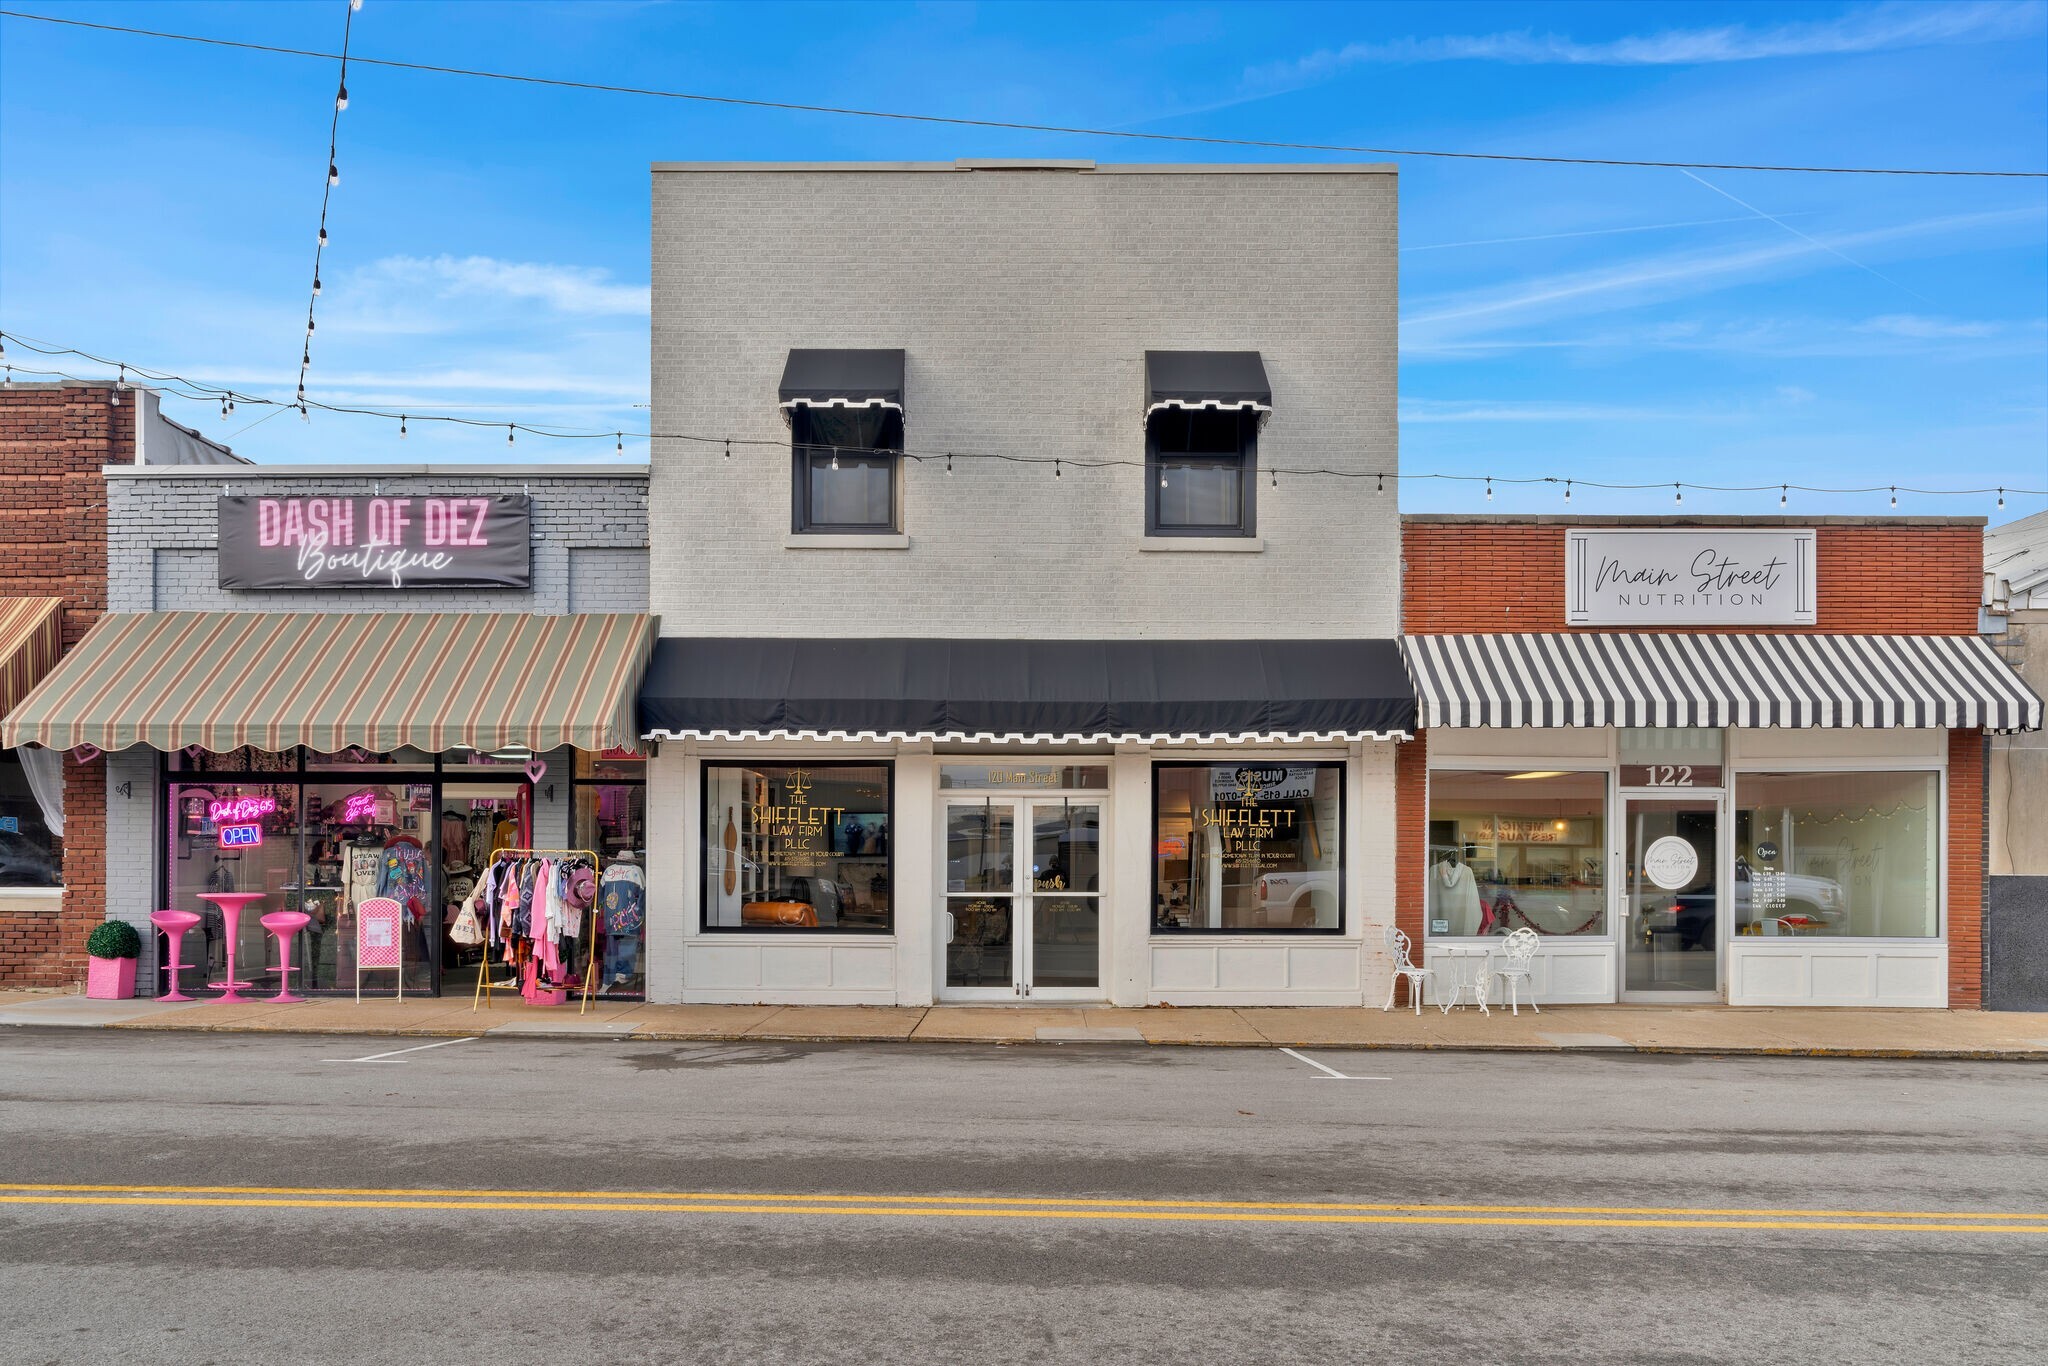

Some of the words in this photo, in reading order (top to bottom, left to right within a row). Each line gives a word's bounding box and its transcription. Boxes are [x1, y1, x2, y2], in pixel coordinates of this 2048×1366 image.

[259, 499, 353, 547] DASH
[368, 499, 411, 546] OF
[425, 499, 488, 546] DEZ
[297, 531, 454, 588] Boutique
[1596, 556, 1678, 592] Main
[1691, 548, 1787, 592] Street
[1619, 593, 1763, 606] NUTRITION
[988, 770, 1003, 783] 120
[1006, 770, 1026, 783] Main
[1029, 769, 1058, 783] Street
[1645, 765, 1693, 787] 122
[789, 795, 808, 804] THE
[1241, 797, 1259, 807] THE
[211, 802, 232, 820] Dash
[240, 800, 259, 818] Dez
[260, 800, 273, 811] 615
[751, 806, 845, 825] SHIFFLETT
[1201, 809, 1296, 827] SHIFFLETT
[223, 827, 259, 845] OPEN
[773, 825, 794, 837] LAW
[799, 825, 823, 837] FIRM
[1223, 827, 1245, 839] LAW
[1249, 827, 1274, 839] FIRM
[785, 838, 810, 850] PLLC
[1235, 840, 1261, 851] PLLC
[1671, 853, 1696, 866] Street
[1757, 847, 1777, 858] Open
[1034, 875, 1066, 893] push
